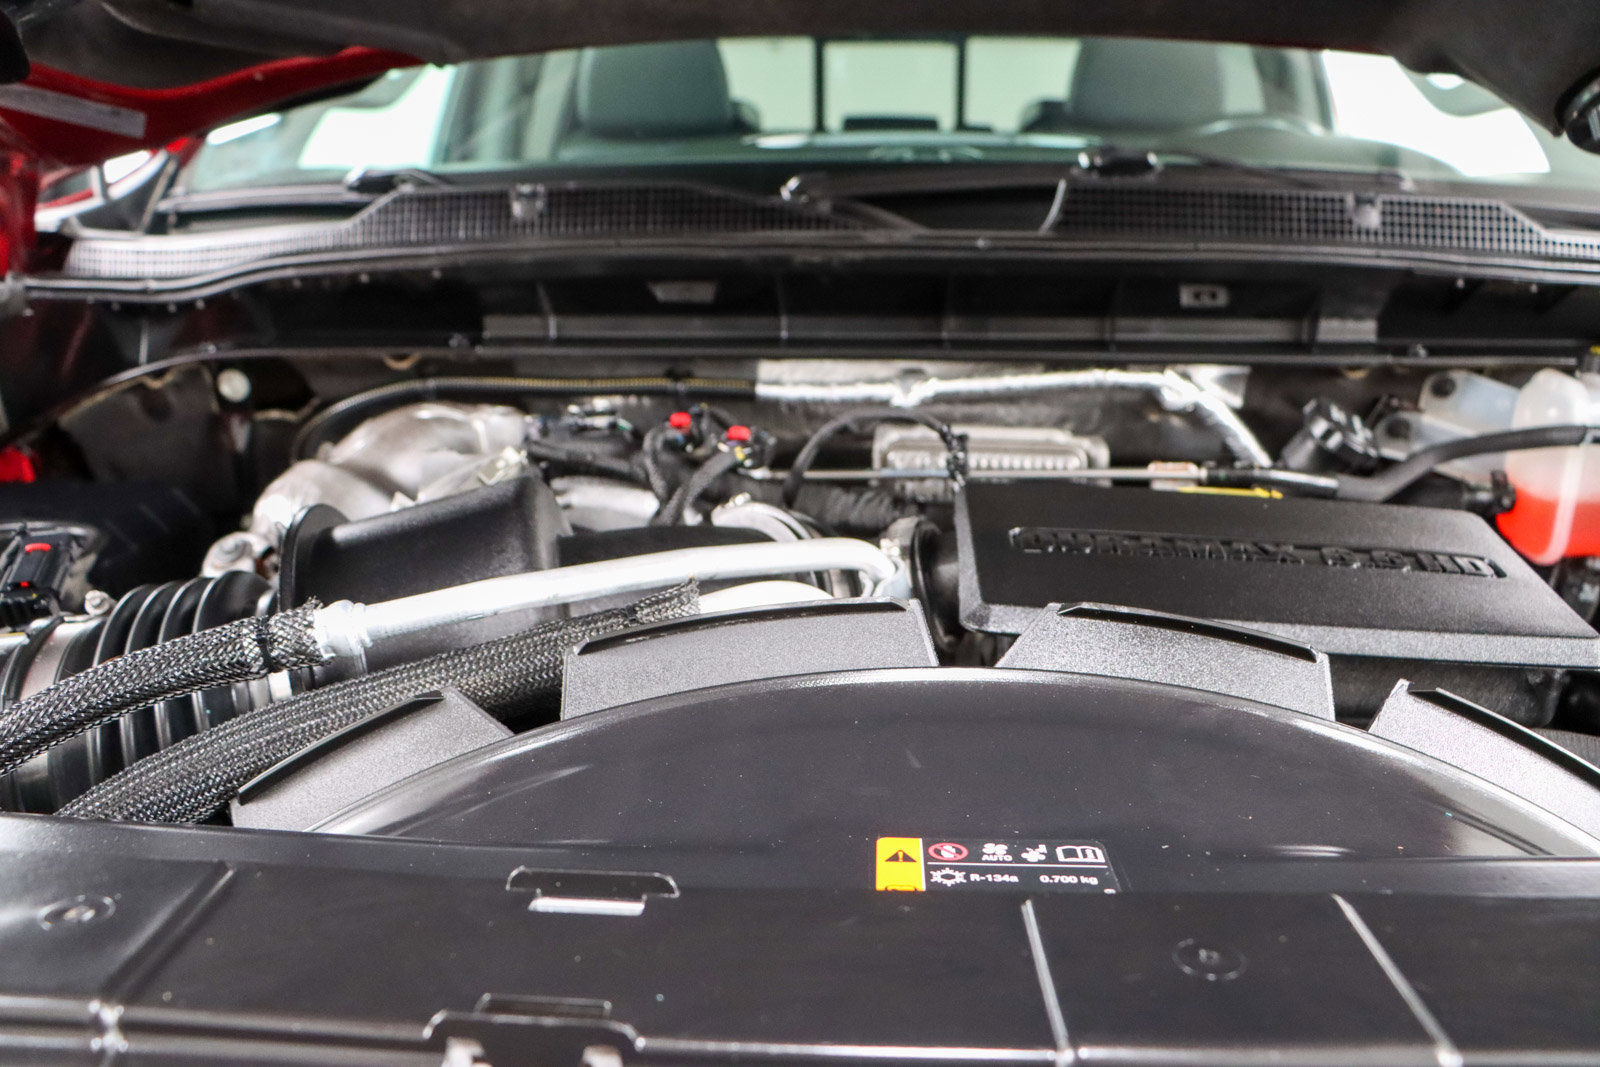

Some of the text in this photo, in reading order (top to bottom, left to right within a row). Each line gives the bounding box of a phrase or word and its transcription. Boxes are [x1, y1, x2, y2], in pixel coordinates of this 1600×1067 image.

[970, 873, 1099, 885] R-134a 0.700 kg
